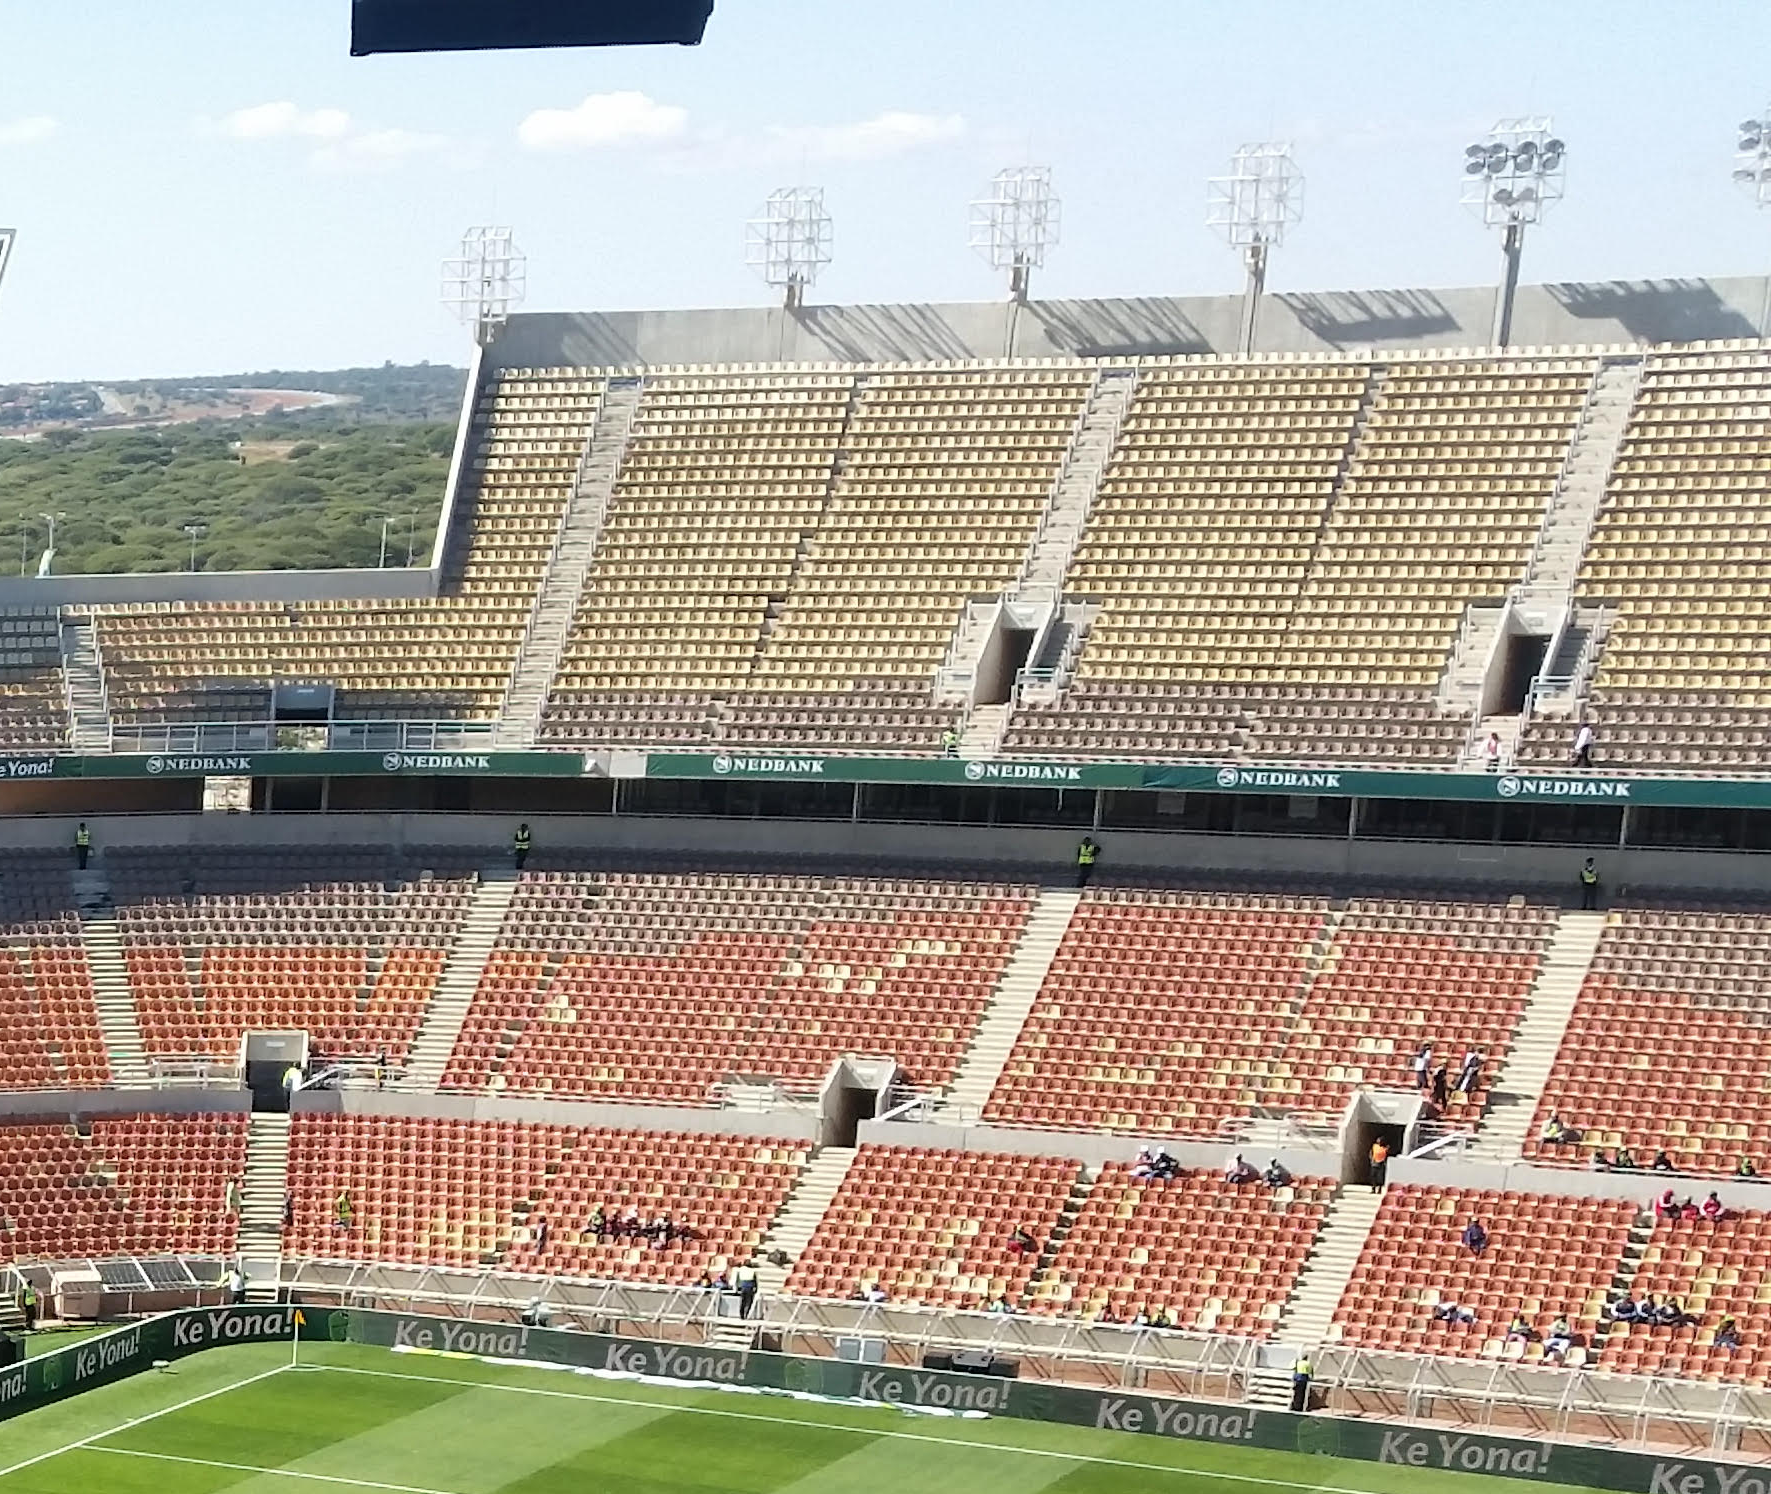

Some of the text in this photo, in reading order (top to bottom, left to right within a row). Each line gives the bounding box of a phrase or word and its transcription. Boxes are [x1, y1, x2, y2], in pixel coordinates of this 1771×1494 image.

[7, 757, 56, 777] Yona!
[165, 756, 252, 771] NEDBANK
[403, 754, 491, 770] NEDBANK
[733, 757, 825, 774] NEDBANK
[986, 764, 1082, 781] NEDBANK
[1239, 770, 1341, 789] NEDBANK
[1521, 779, 1631, 798] NEDBANK
[173, 1308, 296, 1348] Ke Yona!
[396, 1319, 529, 1357] Ke Yona!
[75, 1328, 141, 1382] Ke Yona!
[606, 1343, 748, 1382] Ke Yona!
[861, 1370, 1011, 1411] Ke Yona!
[1097, 1398, 1258, 1441] Ke Yona!
[1380, 1431, 1553, 1476] Ke Yona!
